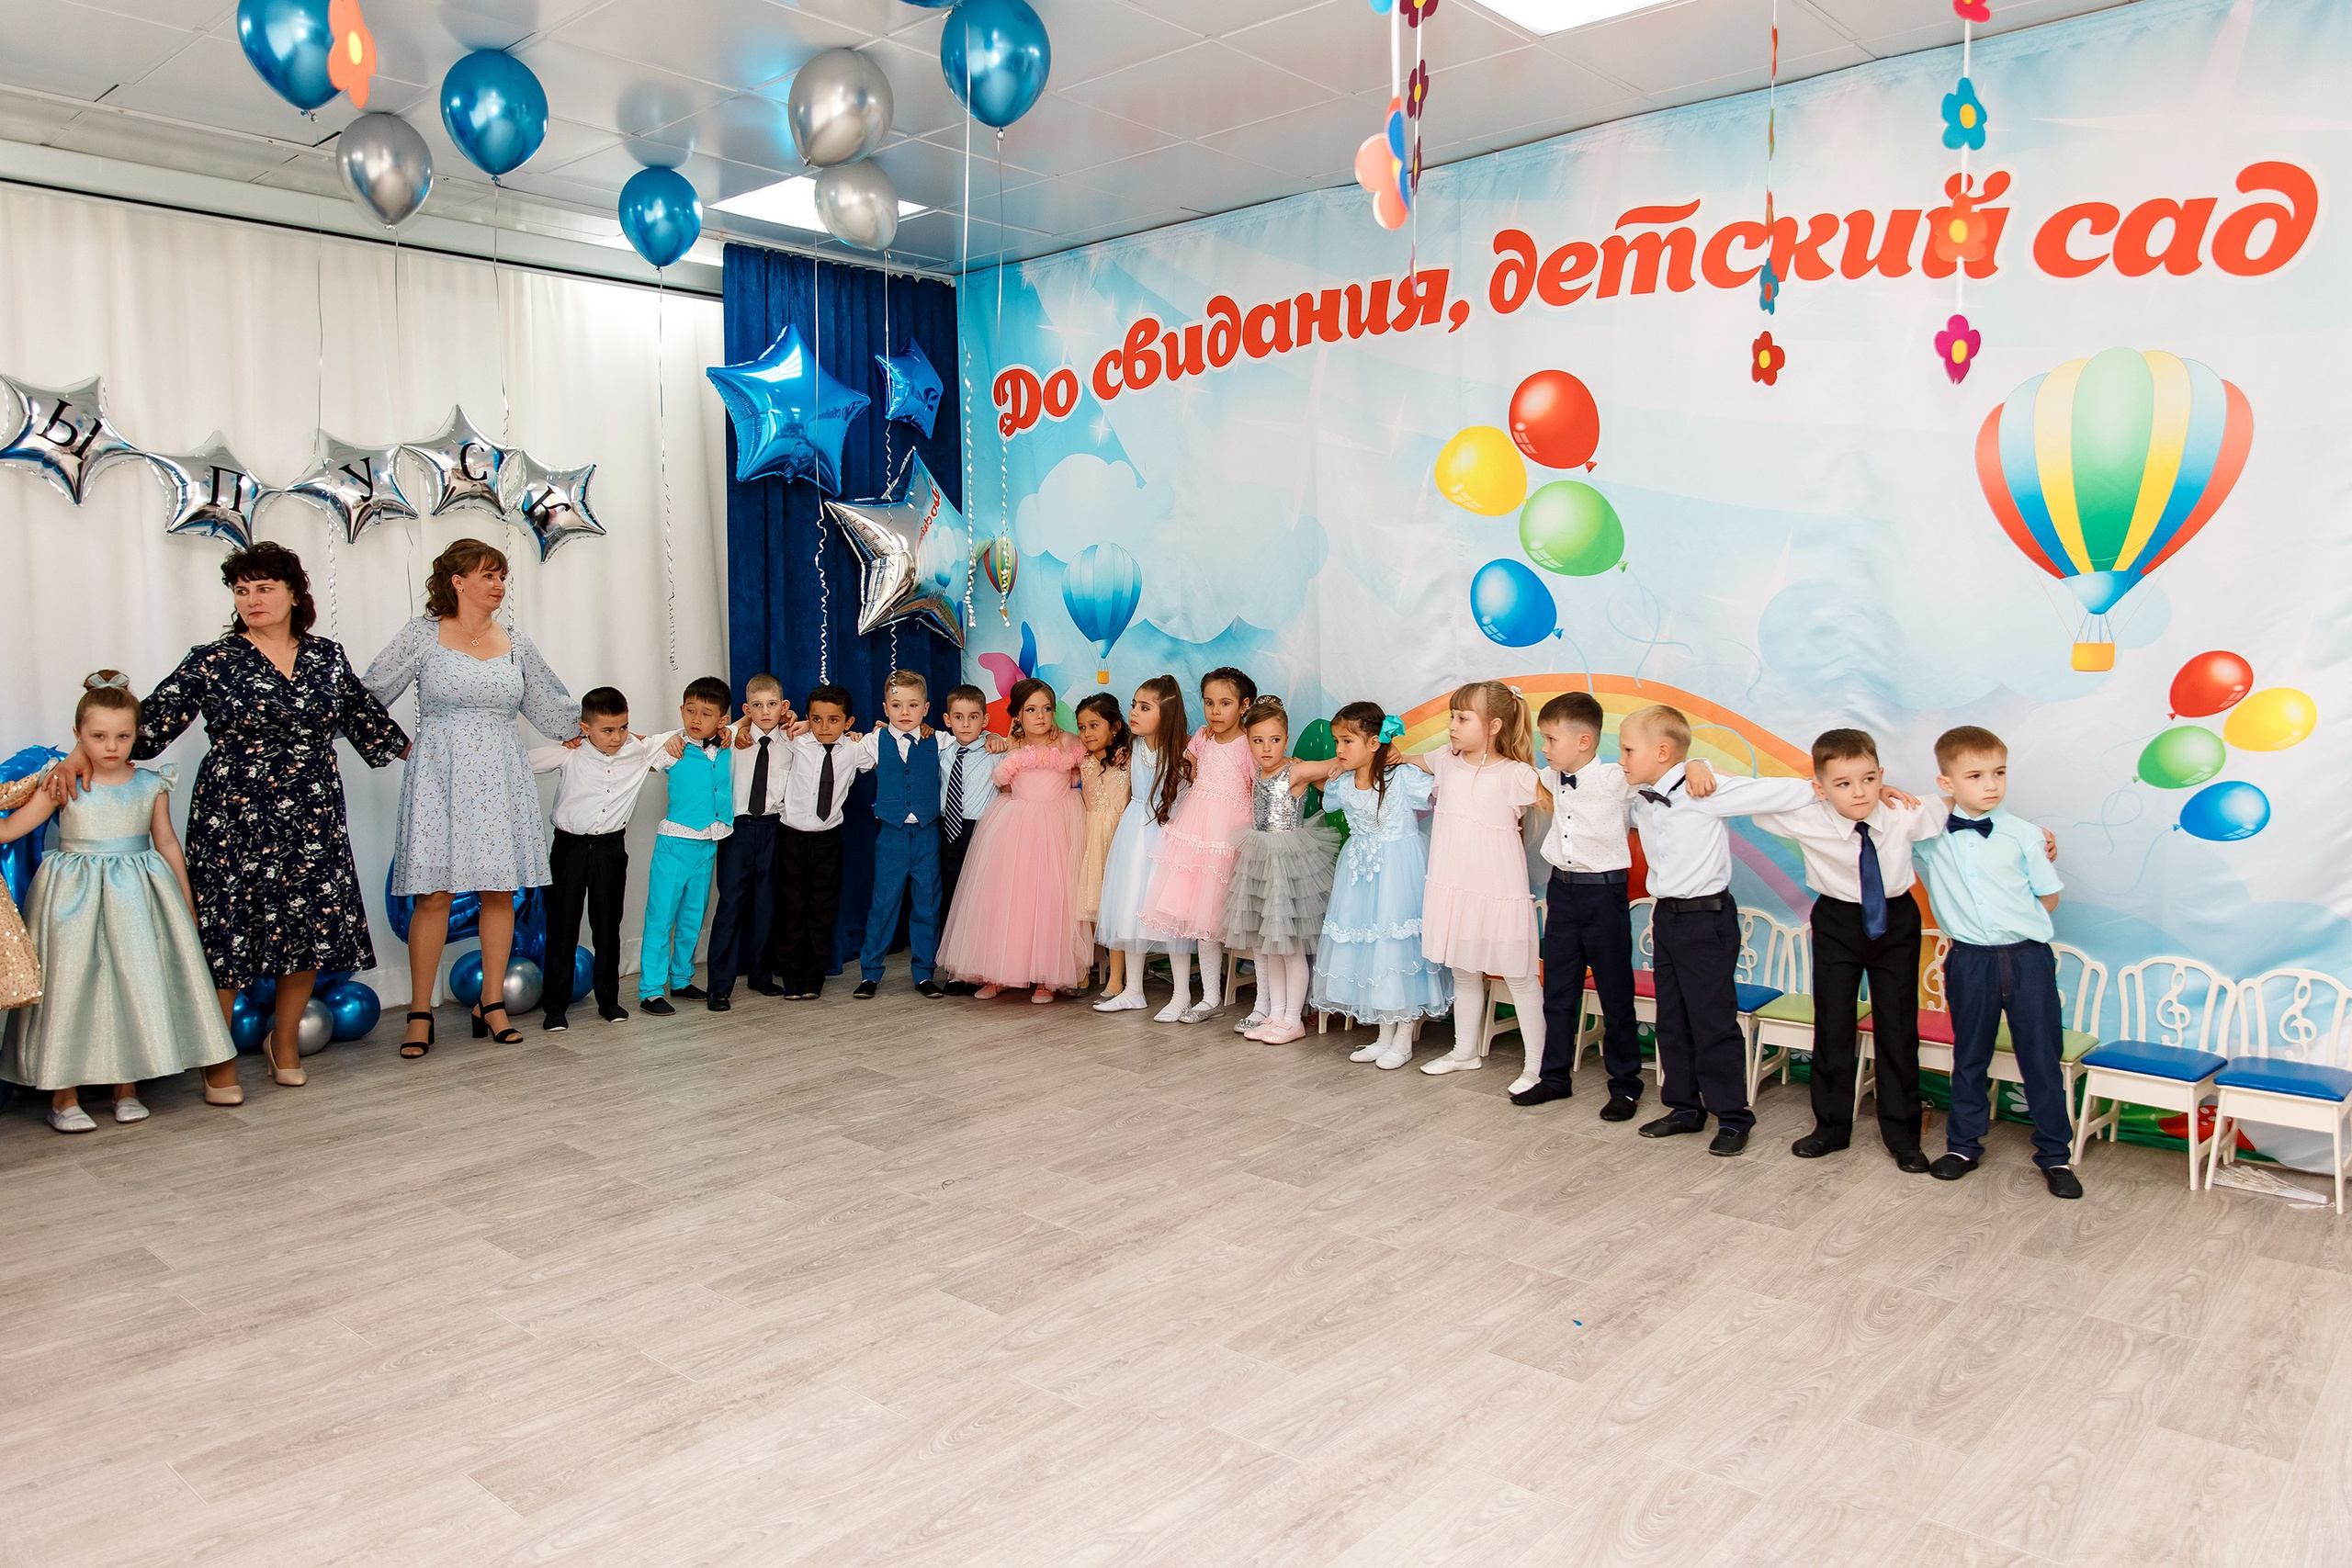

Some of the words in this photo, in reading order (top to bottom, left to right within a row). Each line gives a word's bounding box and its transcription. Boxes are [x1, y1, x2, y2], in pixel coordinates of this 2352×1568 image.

[993, 368, 1079, 437] До
[1092, 268, 1470, 400] свидания,
[1488, 170, 2011, 314] детский
[2033, 161, 2318, 278] сад
